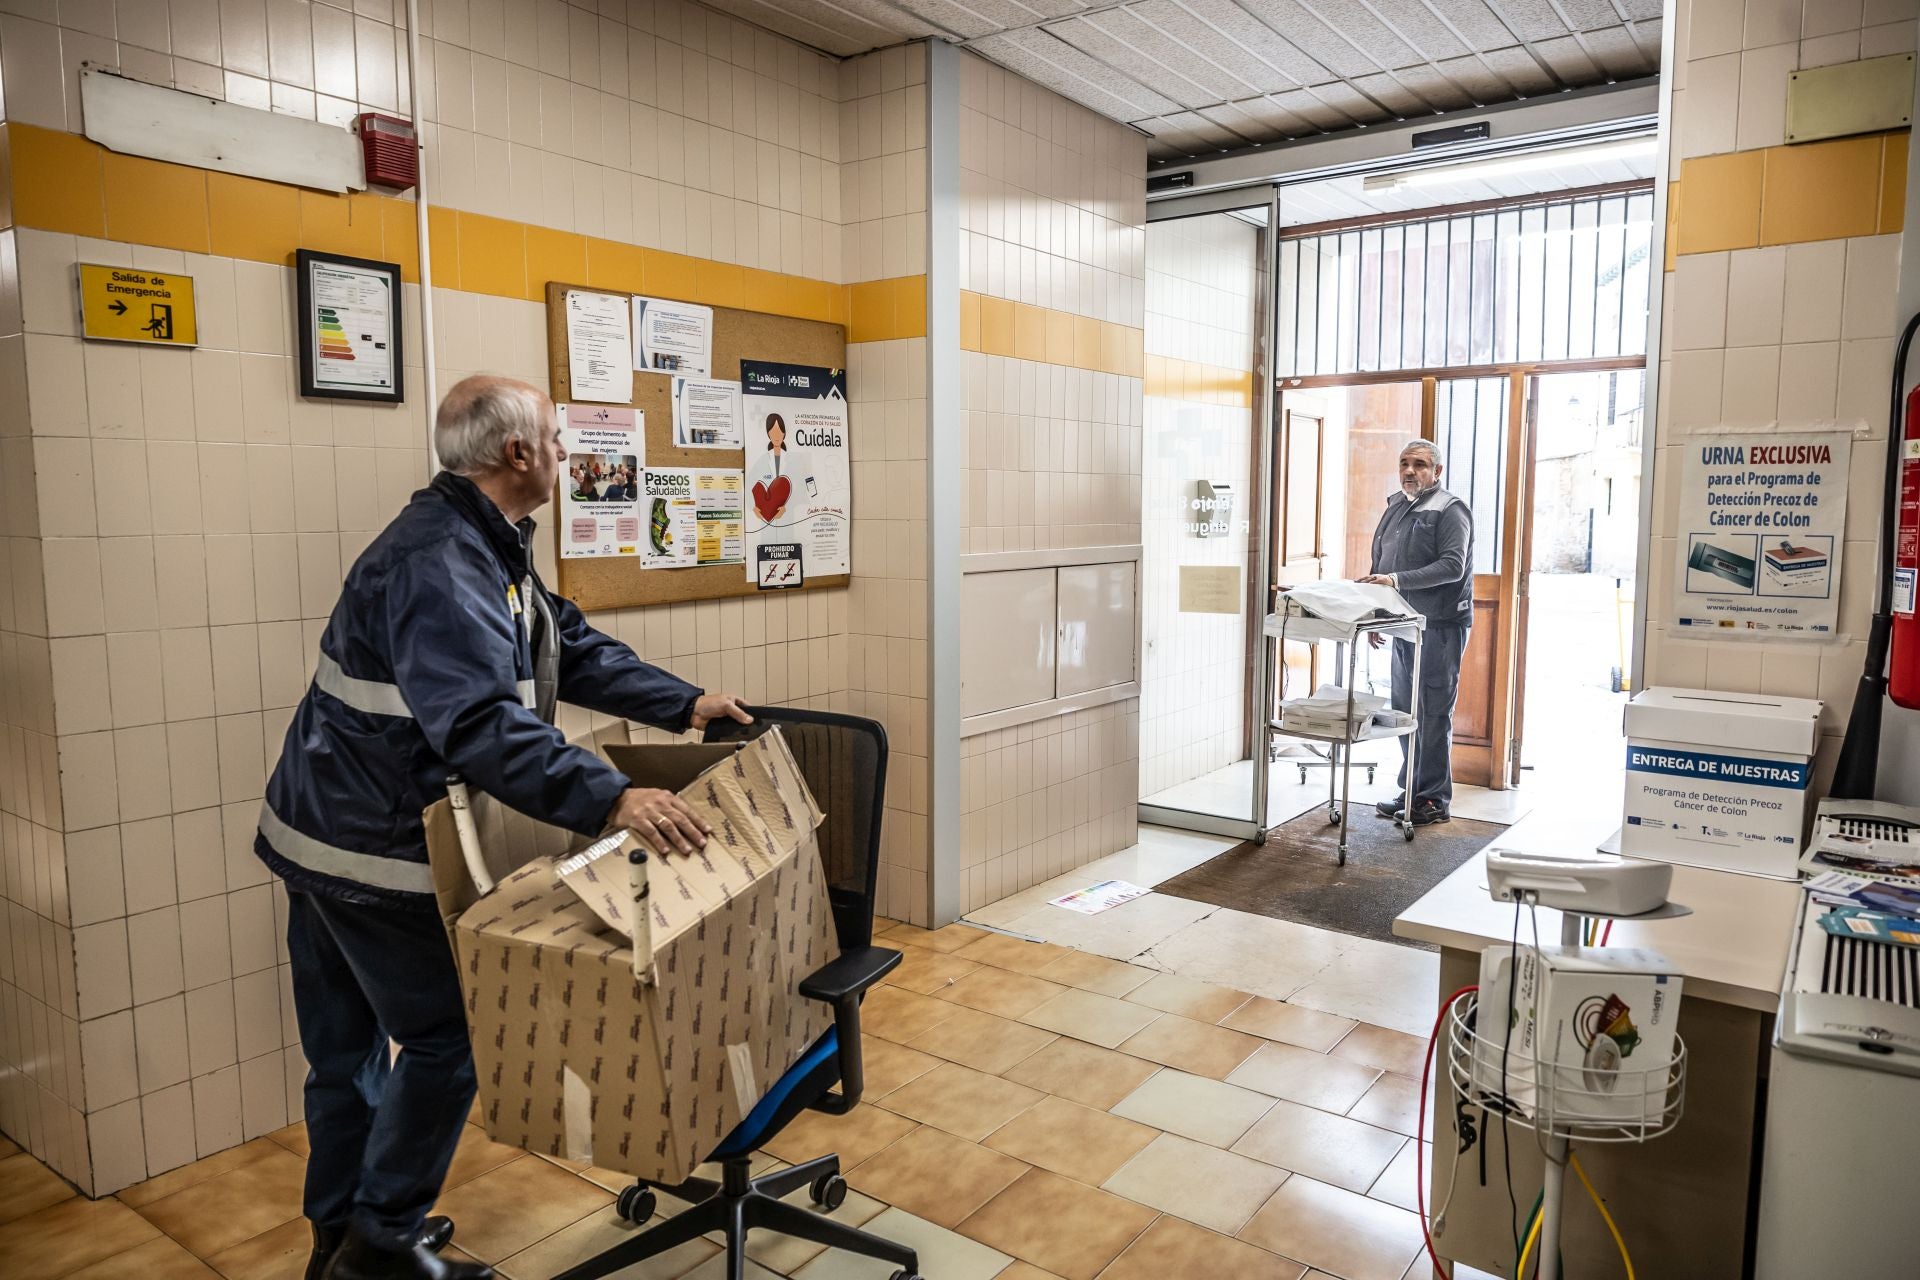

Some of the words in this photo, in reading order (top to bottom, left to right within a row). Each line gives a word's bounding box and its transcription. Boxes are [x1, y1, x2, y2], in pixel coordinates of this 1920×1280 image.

[112, 271, 146, 284] Salida
[151, 277, 164, 286] de
[106, 283, 171, 298] Emergencia
[757, 374, 764, 382] La
[764, 374, 780, 384] Rioja
[795, 428, 841, 447] Cuídala
[1701, 446, 1745, 465] URNA
[1749, 445, 1831, 465] EXCLUSIVA
[644, 472, 690, 486] Paseos
[1708, 474, 1733, 488] para
[1734, 472, 1745, 485] el
[1748, 471, 1803, 488] Programa
[1806, 471, 1821, 485] de
[646, 486, 691, 495] Saludables
[1707, 491, 1761, 506] Detección
[1763, 492, 1801, 506] Precoz
[1803, 492, 1818, 506] de
[1709, 510, 1752, 526] Cáncer
[1754, 510, 1770, 526] de
[1773, 511, 1810, 527] Colon
[764, 545, 795, 553] PROHIBIDO
[1706, 604, 1798, 614] www.riojasalud.es/colon
[1632, 753, 1695, 771] ENTREGA
[1699, 760, 1718, 773] DE
[1721, 763, 1800, 783] MUESTRAS
[1643, 785, 1686, 798] Programa
[1688, 791, 1700, 800] de
[1702, 793, 1748, 806] Detección
[1750, 798, 1782, 810] Precoz
[1674, 800, 1703, 811] Cáncer
[1706, 805, 1719, 813] de
[1721, 806, 1747, 816] Colon
[1525, 1020, 1535, 1049] MESI
